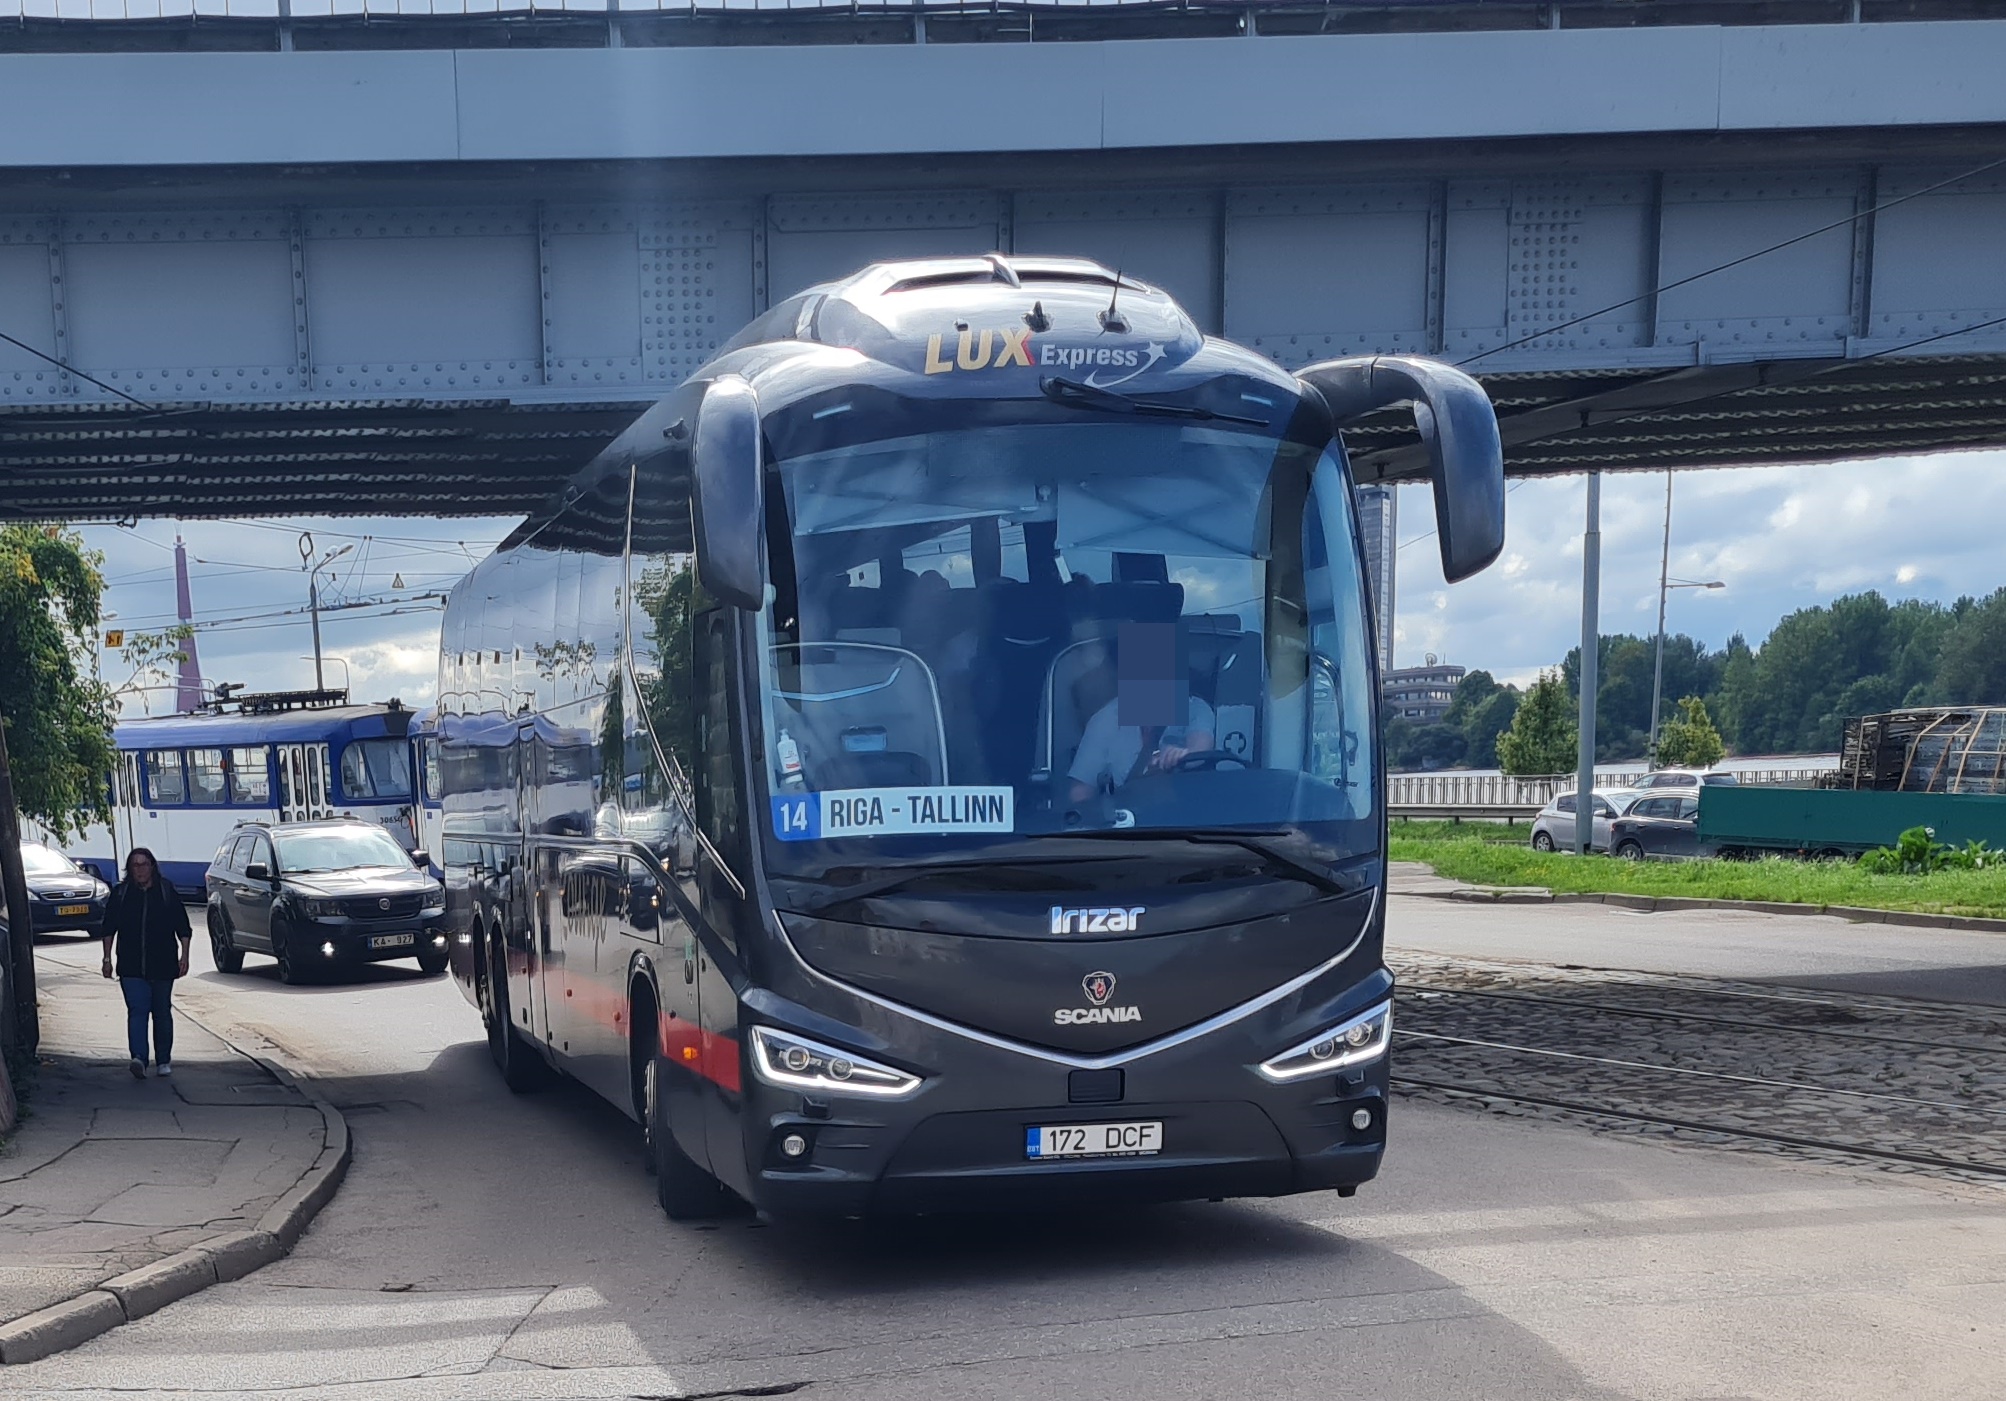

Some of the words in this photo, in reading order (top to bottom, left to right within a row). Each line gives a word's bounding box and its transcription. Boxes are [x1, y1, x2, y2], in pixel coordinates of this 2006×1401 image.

[925, 328, 1035, 375] LUX
[1041, 344, 1138, 370] Express
[780, 801, 807, 832] 14
[830, 797, 884, 828] RIGA
[907, 794, 1004, 824] TALLINN
[1051, 905, 1146, 934] Irizar
[1054, 1006, 1142, 1025] SCANIA
[1049, 1128, 1086, 1152] 172
[1105, 1124, 1155, 1150] DCF
